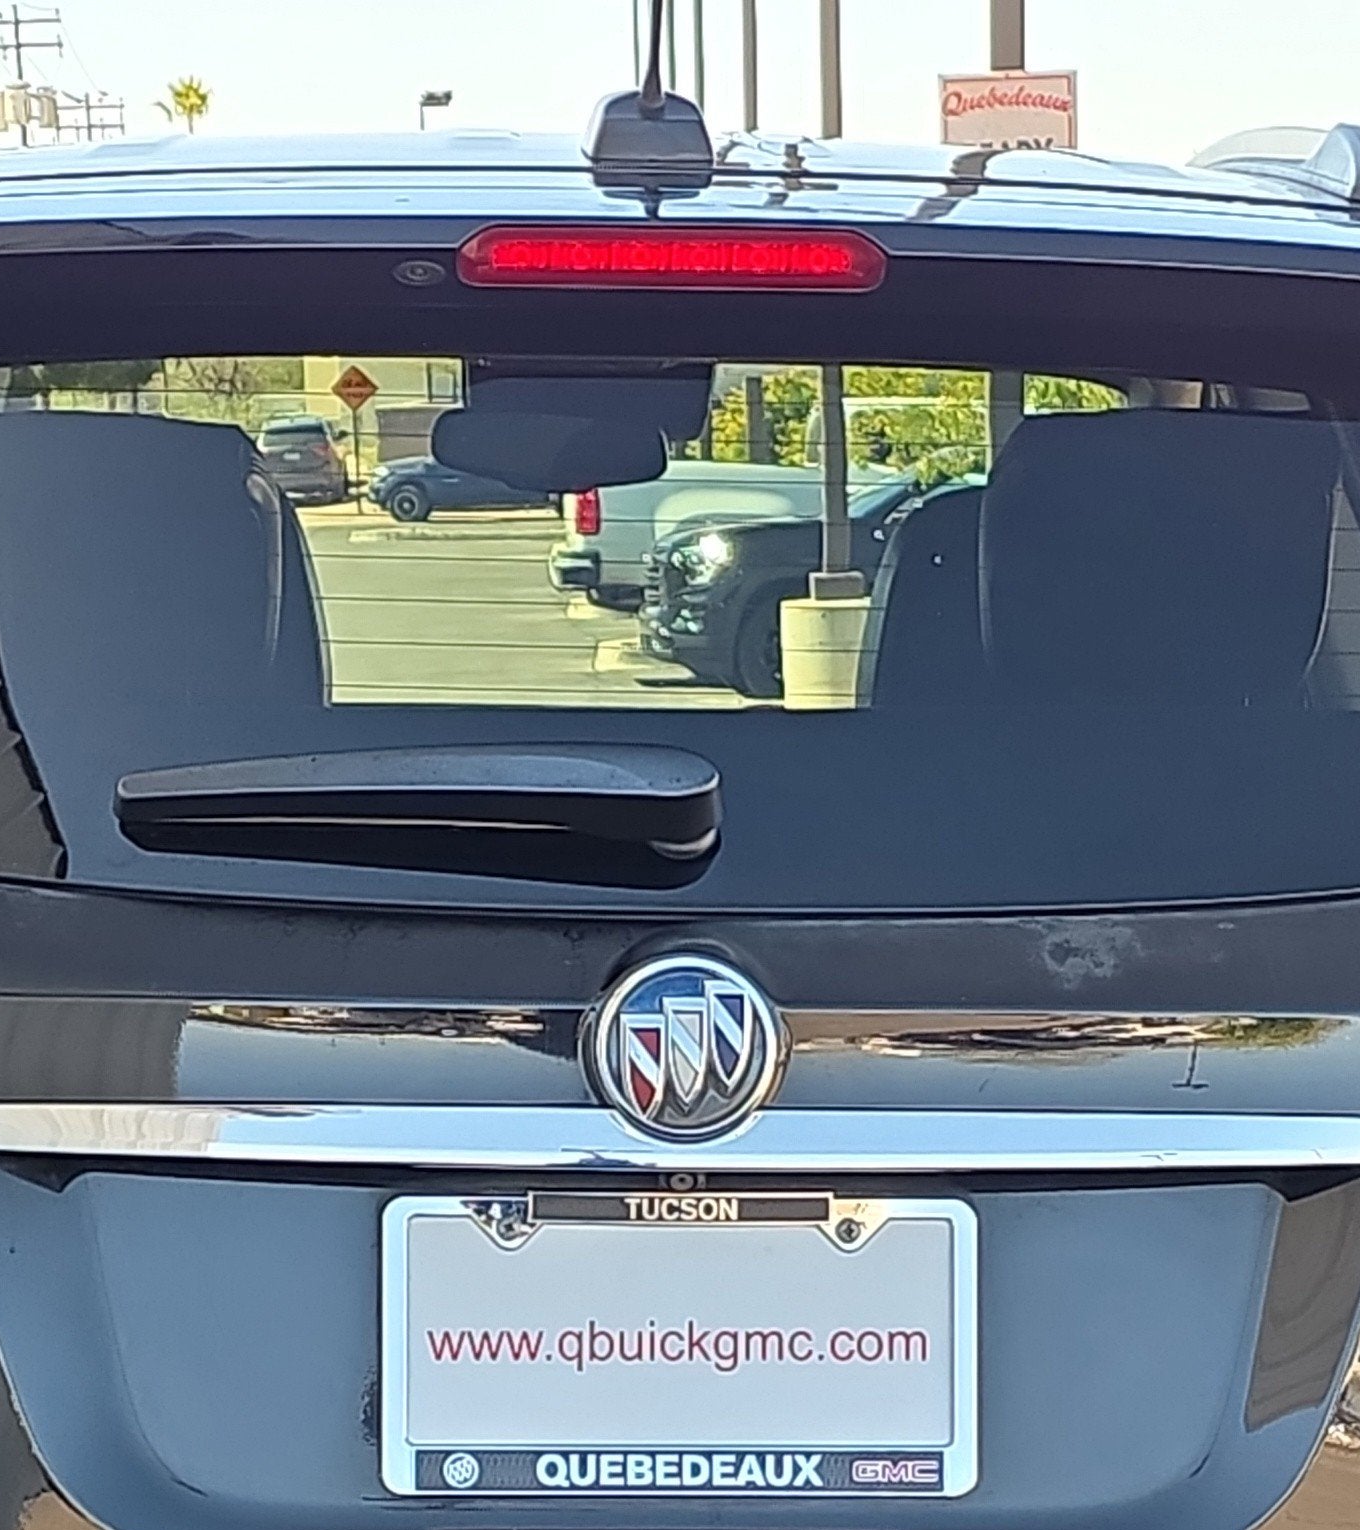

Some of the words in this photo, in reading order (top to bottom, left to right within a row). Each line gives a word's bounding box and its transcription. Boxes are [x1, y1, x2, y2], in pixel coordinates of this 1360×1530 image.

[942, 85, 1070, 116] Quebedeaux
[624, 1198, 738, 1220] TUCSON
[427, 1321, 928, 1371] www.qbuickgmc.com
[536, 1454, 824, 1487] QUEBEDEAUX
[851, 1459, 939, 1484] GMC
